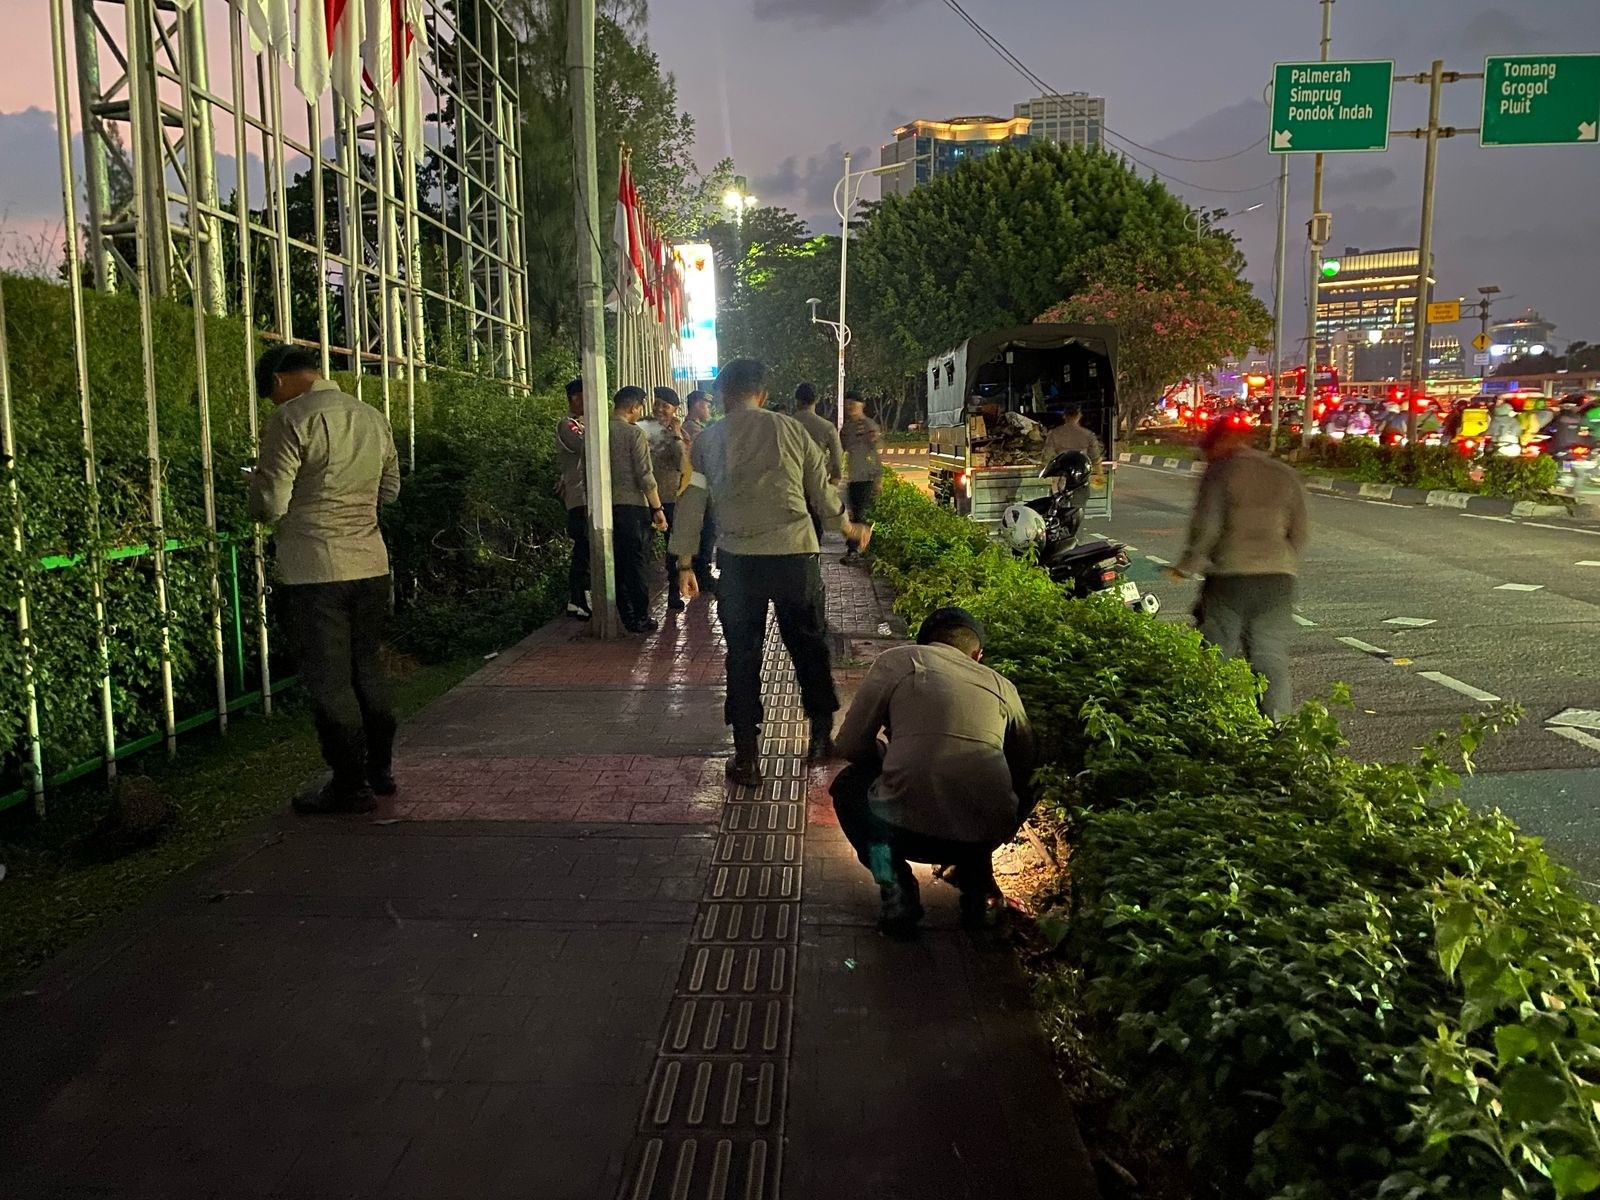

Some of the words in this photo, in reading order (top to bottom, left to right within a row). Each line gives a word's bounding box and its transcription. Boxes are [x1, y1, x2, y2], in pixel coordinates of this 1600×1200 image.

[1291, 67, 1351, 83] Palmerah
[1503, 62, 1556, 79] Tomang
[1290, 87, 1342, 105] Simprug
[1501, 79, 1549, 98] Grogol
[1288, 105, 1334, 121] Pondok
[1338, 104, 1373, 120] Indah
[1500, 97, 1532, 114] Pluit
